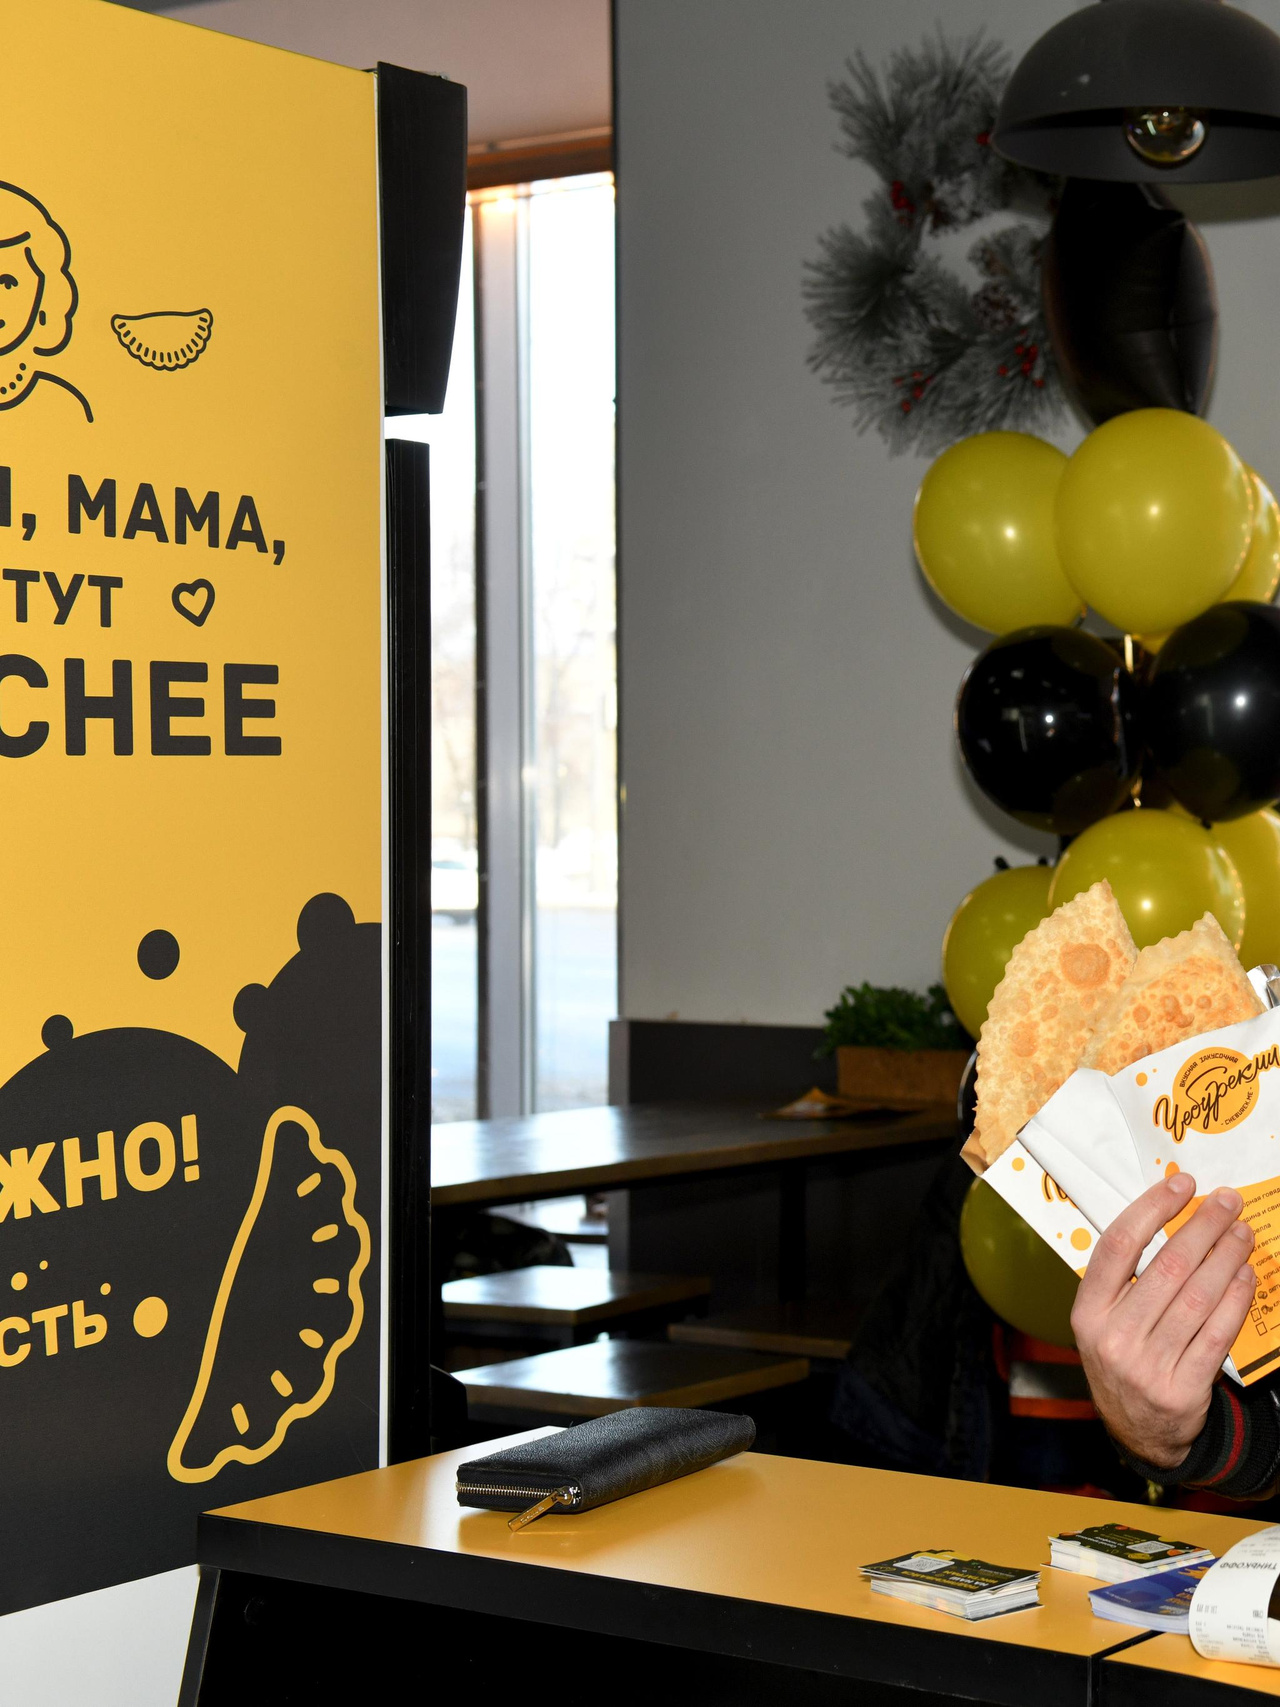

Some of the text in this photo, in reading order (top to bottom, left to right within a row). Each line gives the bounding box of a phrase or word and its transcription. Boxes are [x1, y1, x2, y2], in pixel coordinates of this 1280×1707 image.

[68, 474, 285, 566] МАМА,
[2, 568, 123, 628] ТУТ
[0, 654, 282, 758] СНЕЕ
[1179, 1052, 1239, 1088] ВКУСНАЯ ЗАКУСОЧНАЯ
[1225, 1091, 1254, 1126] CHEBUREK.ME
[0, 1114, 200, 1223] ЖНО!
[1242, 1211, 1261, 1223] ядина
[1243, 1195, 1261, 1207] орная
[1253, 1222, 1272, 1235] релла
[0, 1300, 107, 1367] СТЬ
[1219, 1562, 1278, 1571] ТИНЬКОФФ
